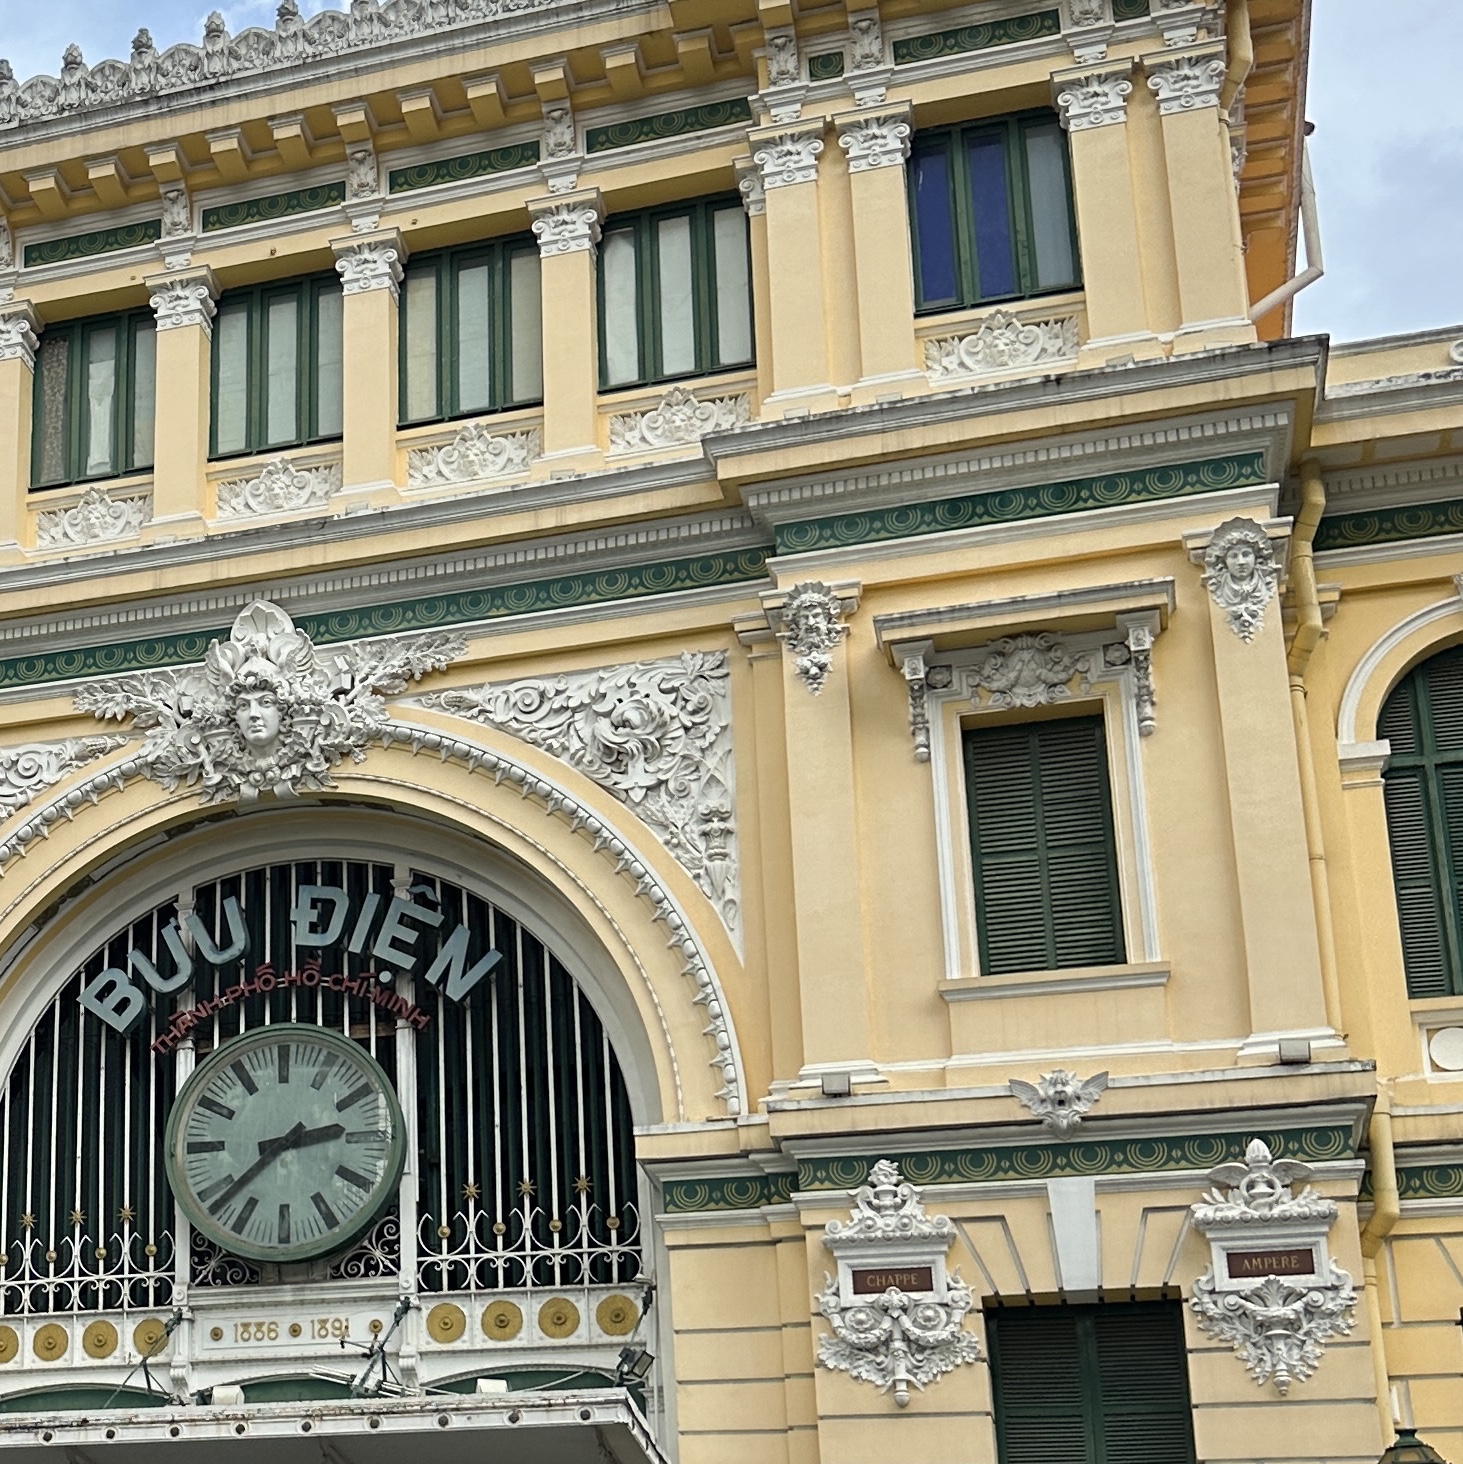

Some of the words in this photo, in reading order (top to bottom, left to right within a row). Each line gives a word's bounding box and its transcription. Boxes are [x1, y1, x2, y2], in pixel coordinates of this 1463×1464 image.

[77, 896, 250, 1034] BƯU
[290, 885, 503, 1001] ĐIỆN
[150, 994, 223, 1054] THÀNH
[225, 962, 278, 1004] PHỐ
[284, 957, 322, 987] HỒ
[328, 972, 377, 998] CHÍ
[371, 985, 433, 1030] MINH
[866, 1272, 919, 1287] CHAPPE
[233, 1321, 279, 1343] 1886
[310, 1317, 351, 1340] 1891
